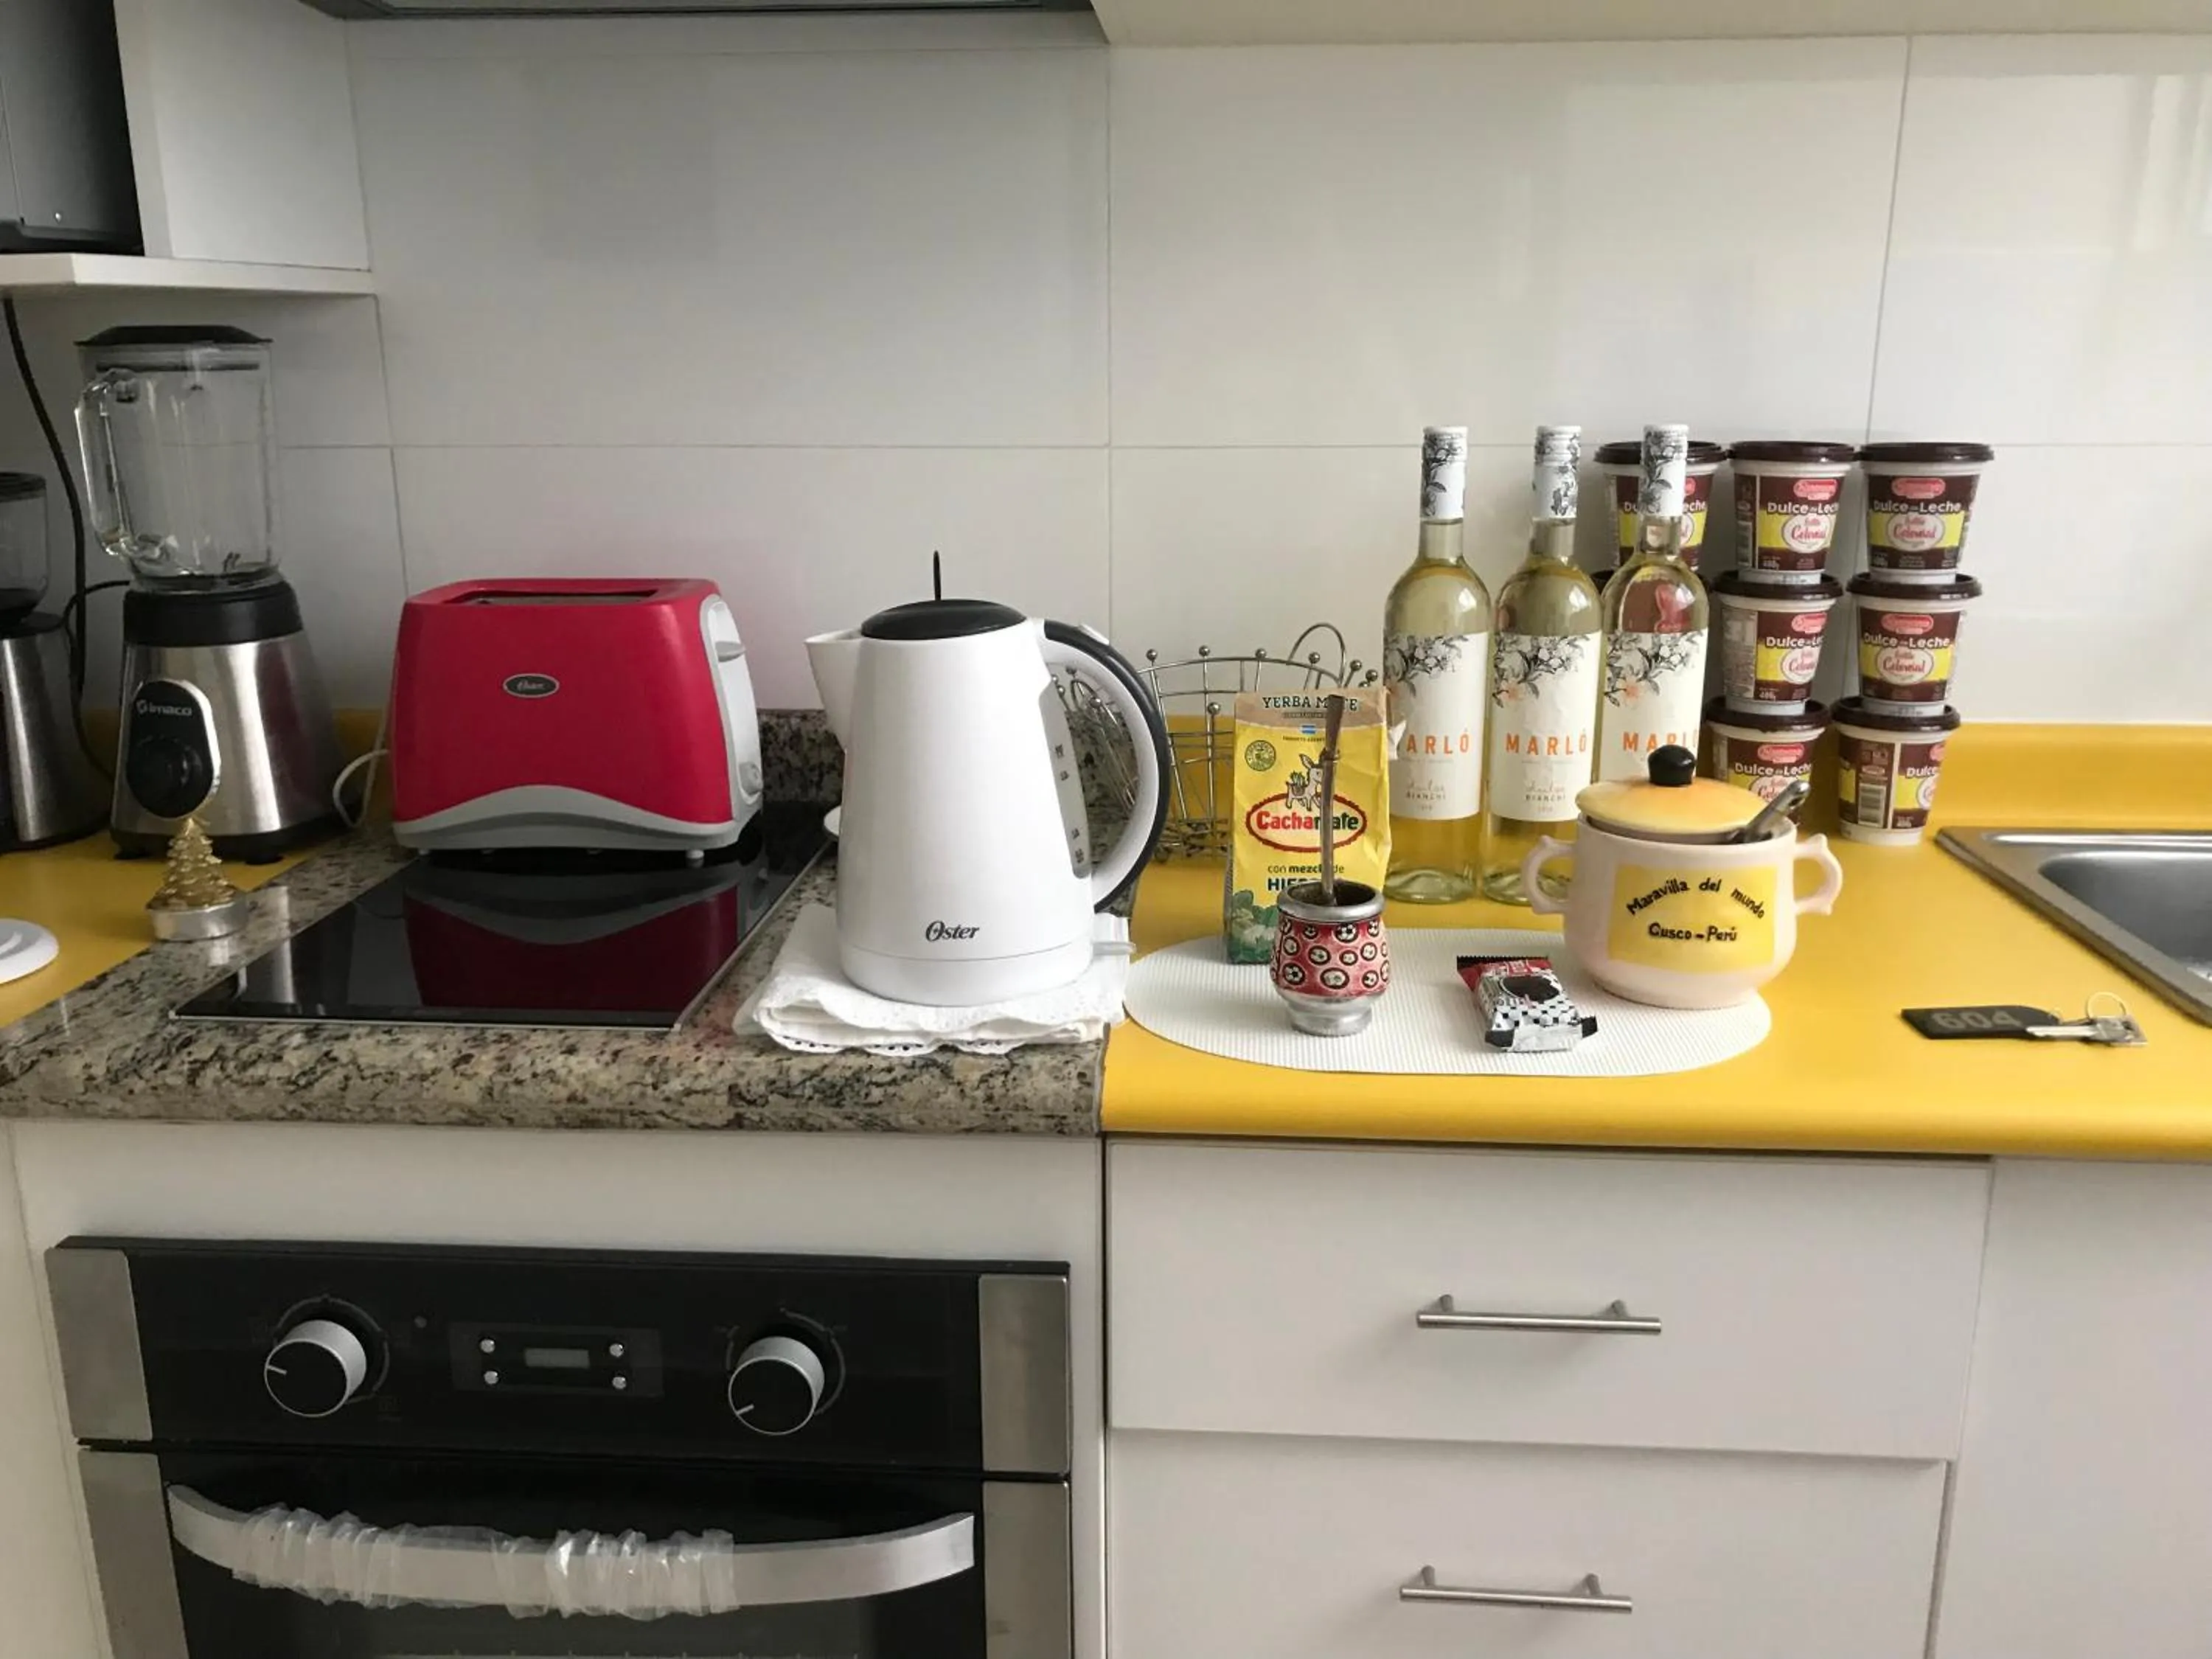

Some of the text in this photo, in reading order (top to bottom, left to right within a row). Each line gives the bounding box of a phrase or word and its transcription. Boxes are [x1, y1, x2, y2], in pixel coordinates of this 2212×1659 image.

[1767, 502, 1809, 515] Dulce
[1874, 500, 1910, 512] Dulce
[1919, 501, 1962, 513] Leche
[1766, 636, 1806, 648] Dulce
[1864, 632, 1898, 647] Dulce
[1909, 638, 1950, 650] Leche
[1262, 696, 1358, 712] YERBA ME
[1406, 727, 1470, 755] ARLÓ
[1506, 728, 1587, 756] MARLÓ
[1734, 762, 1774, 776] Dulce
[1267, 864, 1287, 874] con
[1289, 863, 1322, 874] mezcl
[1626, 877, 1765, 919] Maravilla del mundo
[925, 920, 980, 942] Oster
[1930, 1009, 2022, 1030] 604
